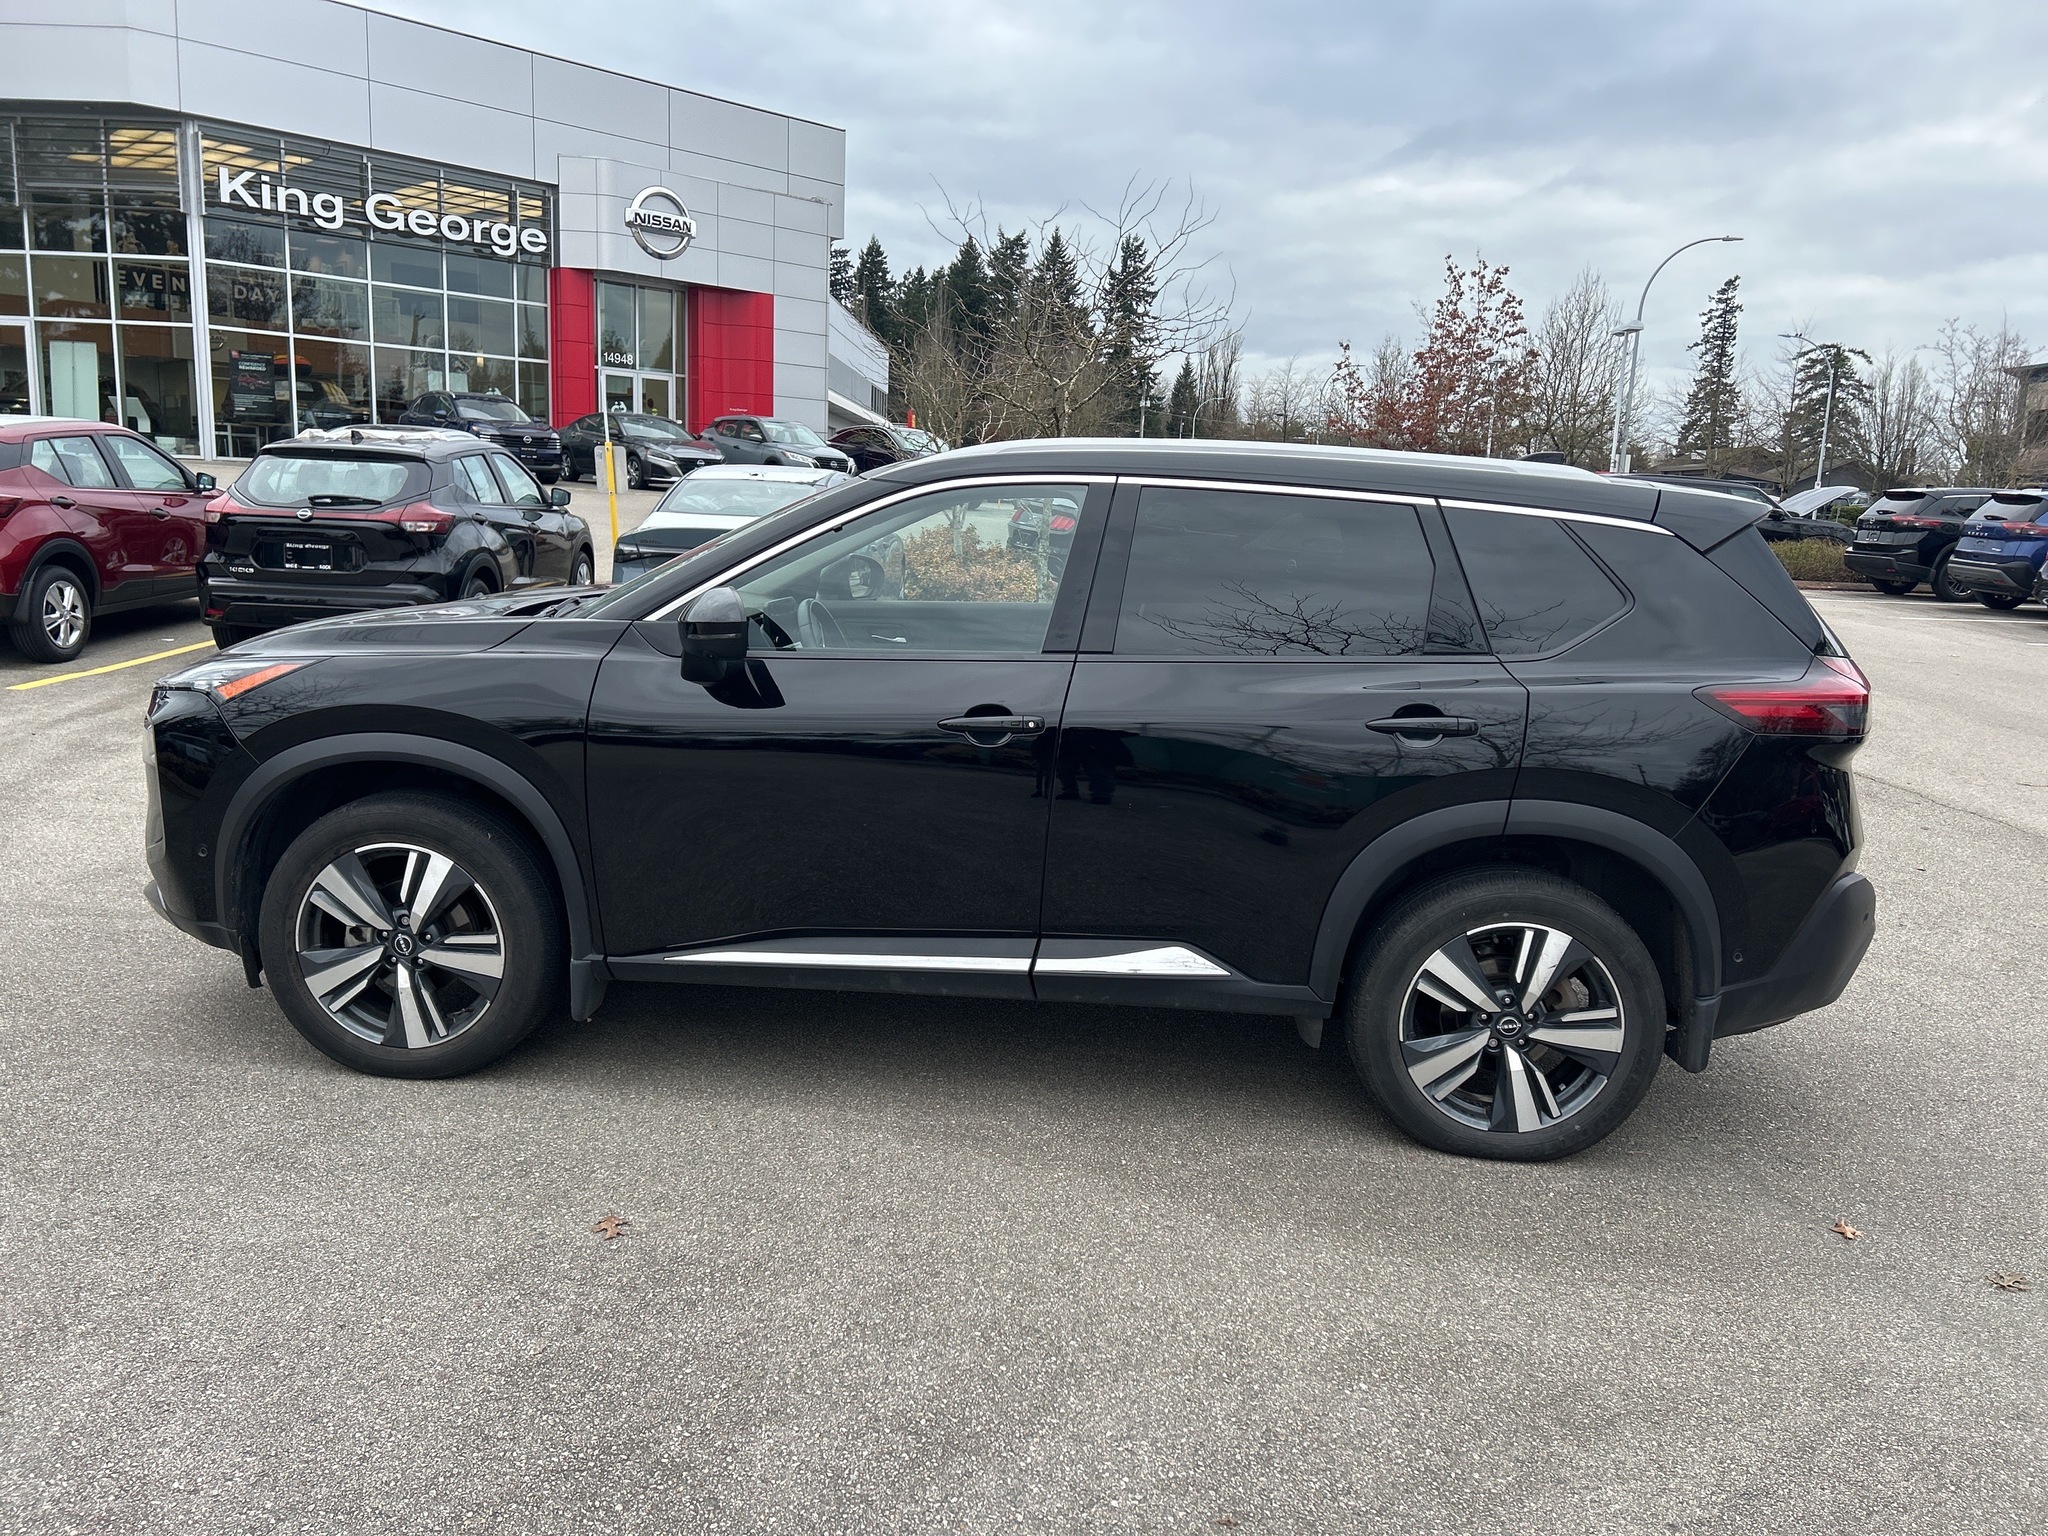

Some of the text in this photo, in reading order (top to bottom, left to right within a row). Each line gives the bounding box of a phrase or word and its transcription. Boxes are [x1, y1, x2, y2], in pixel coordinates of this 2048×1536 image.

[217, 166, 548, 256] King George
[633, 211, 692, 233] NISSAN
[234, 284, 280, 303] DAY
[603, 351, 634, 365] 14948
